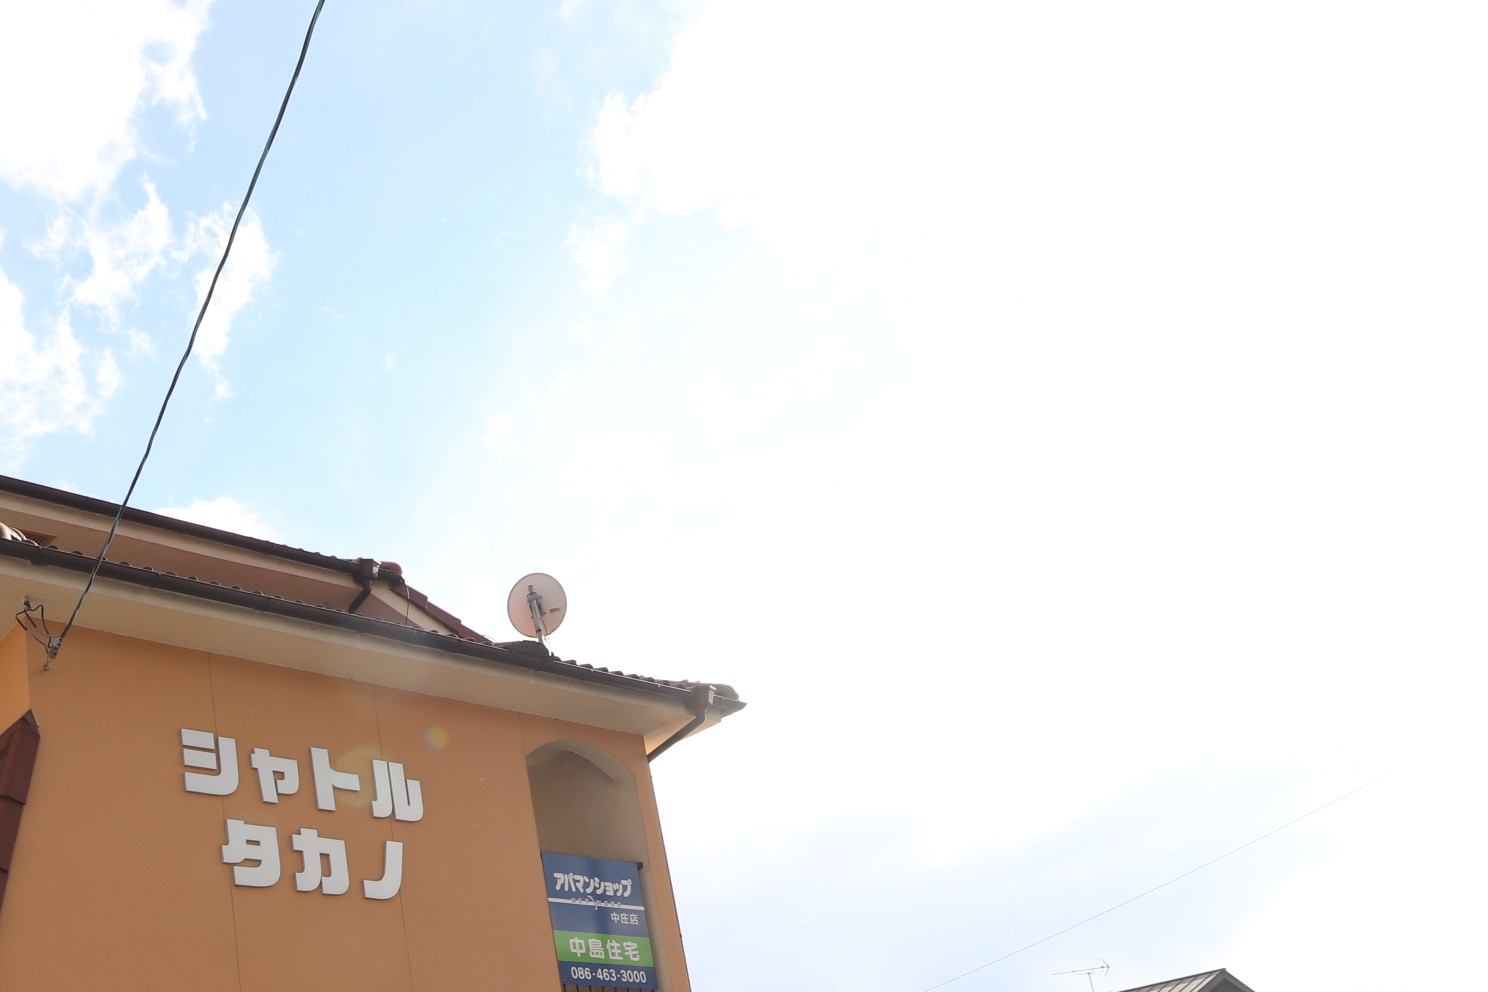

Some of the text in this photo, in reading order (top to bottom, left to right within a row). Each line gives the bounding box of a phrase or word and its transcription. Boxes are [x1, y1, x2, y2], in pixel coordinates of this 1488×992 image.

[180, 728, 424, 822] シャトル
[221, 818, 404, 900] タカノ
[553, 872, 632, 898] アパマンショップ
[610, 911, 639, 925] 中庄店
[569, 936, 640, 962] 中島住宅
[570, 966, 647, 984] 086-463-3000
